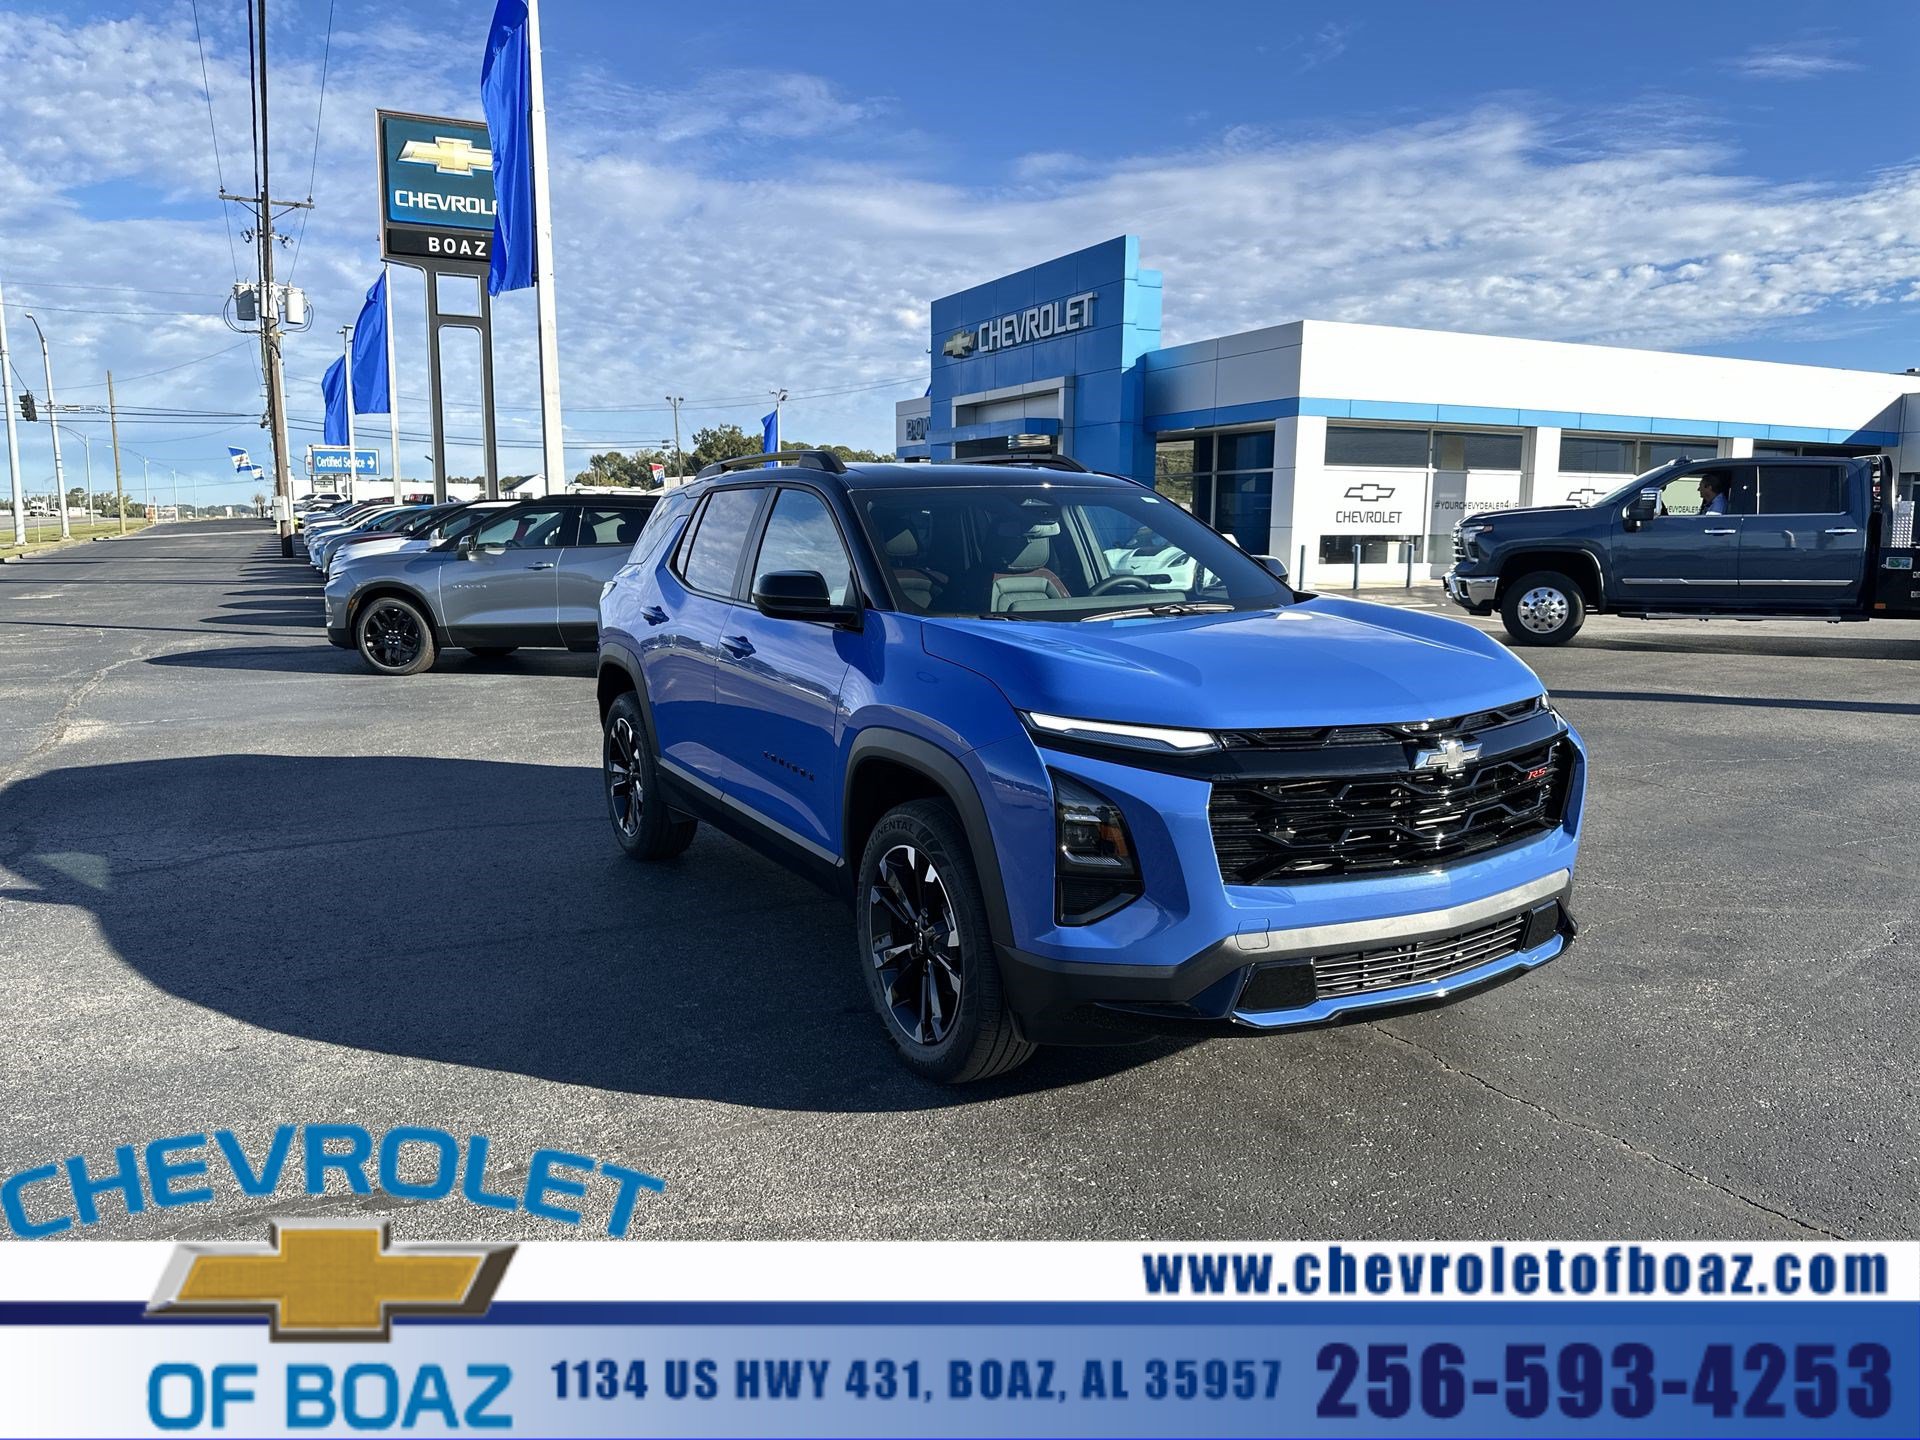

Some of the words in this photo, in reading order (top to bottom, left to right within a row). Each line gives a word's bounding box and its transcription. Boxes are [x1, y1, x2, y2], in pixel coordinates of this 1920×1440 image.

[394, 189, 498, 216] CHEVROL
[428, 236, 487, 257] BOAZ
[978, 292, 1097, 353] CHEVROLET
[316, 455, 342, 468] Certified
[1336, 510, 1402, 524] CHEVROLET
[1526, 767, 1547, 780] RS
